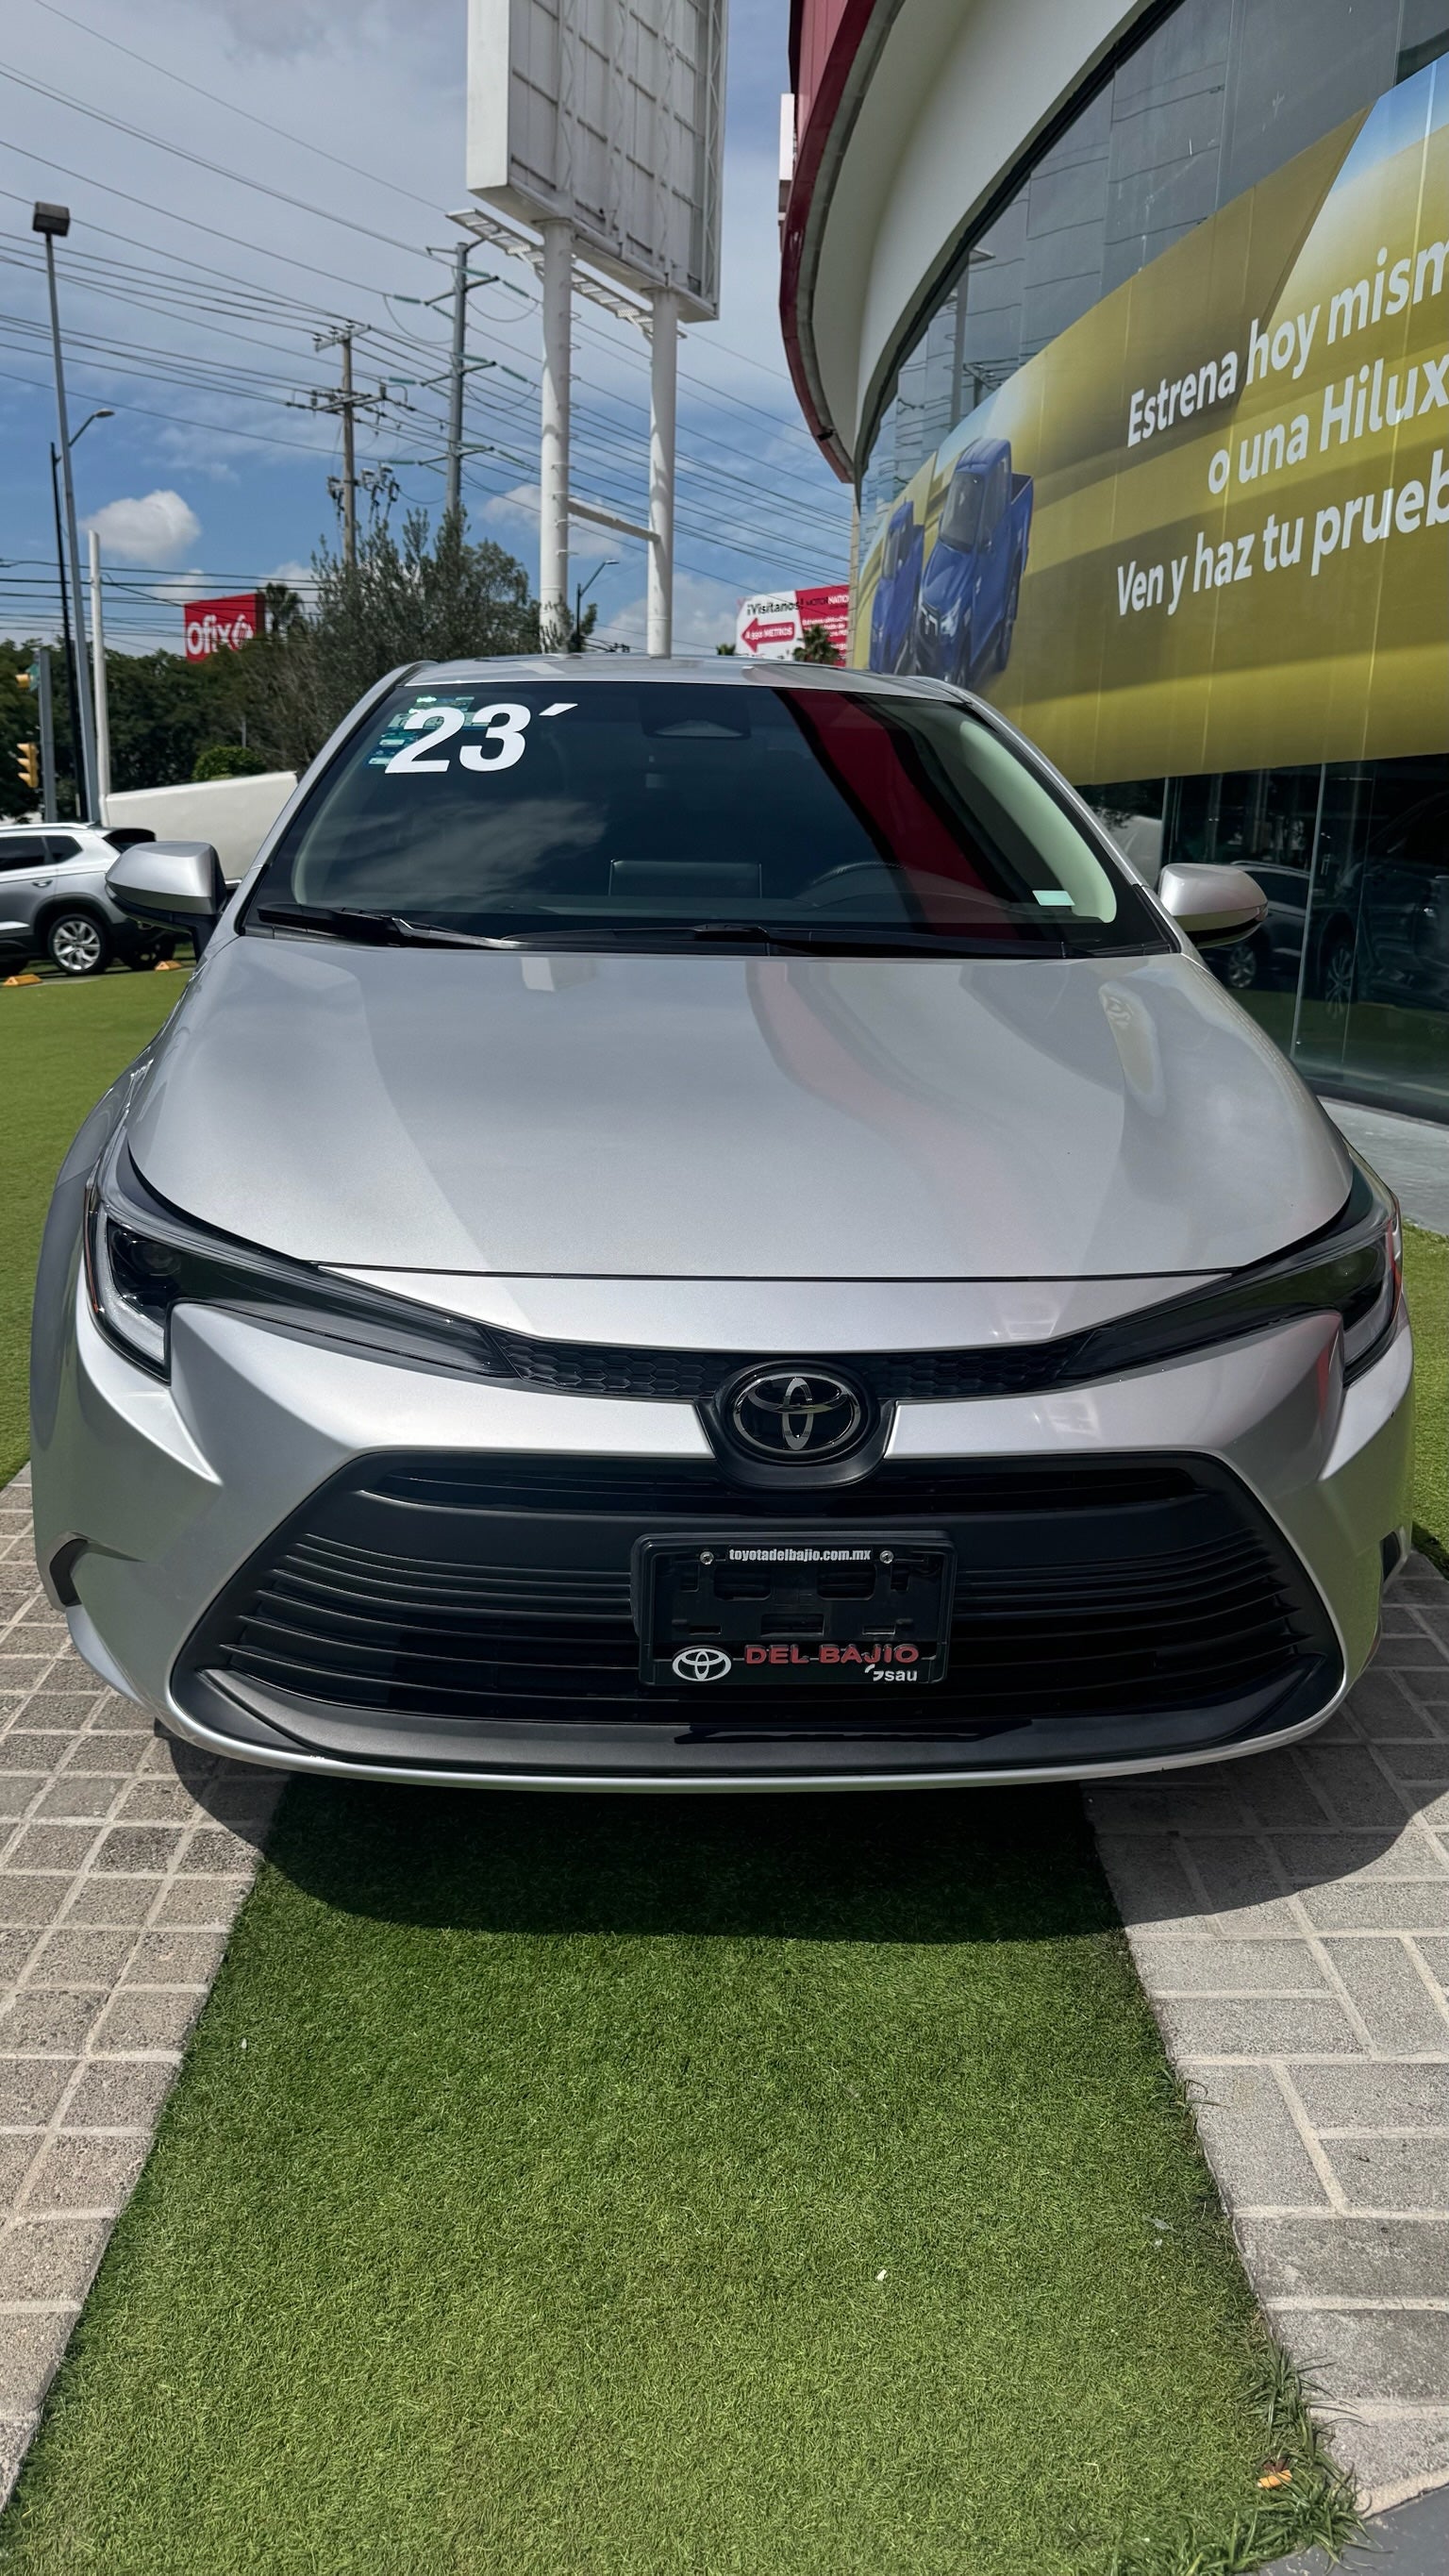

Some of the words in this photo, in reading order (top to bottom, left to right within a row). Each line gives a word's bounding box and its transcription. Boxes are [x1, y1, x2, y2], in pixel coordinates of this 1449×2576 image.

[1126, 351, 1239, 448] Estrena
[1245, 305, 1321, 385] hoy
[1208, 449, 1229, 494] o
[1237, 413, 1309, 484] una
[1319, 354, 1449, 453] Hilux
[1116, 560, 1164, 616] Ven
[1167, 556, 1189, 615] y
[1192, 531, 1256, 593] haz
[1262, 514, 1304, 573] tu
[1310, 448, 1449, 577] prueb
[728, 1548, 872, 1562] toyotadelbajio.com.mx
[743, 1644, 809, 1664] DEL
[819, 1644, 920, 1664] BAJIO
